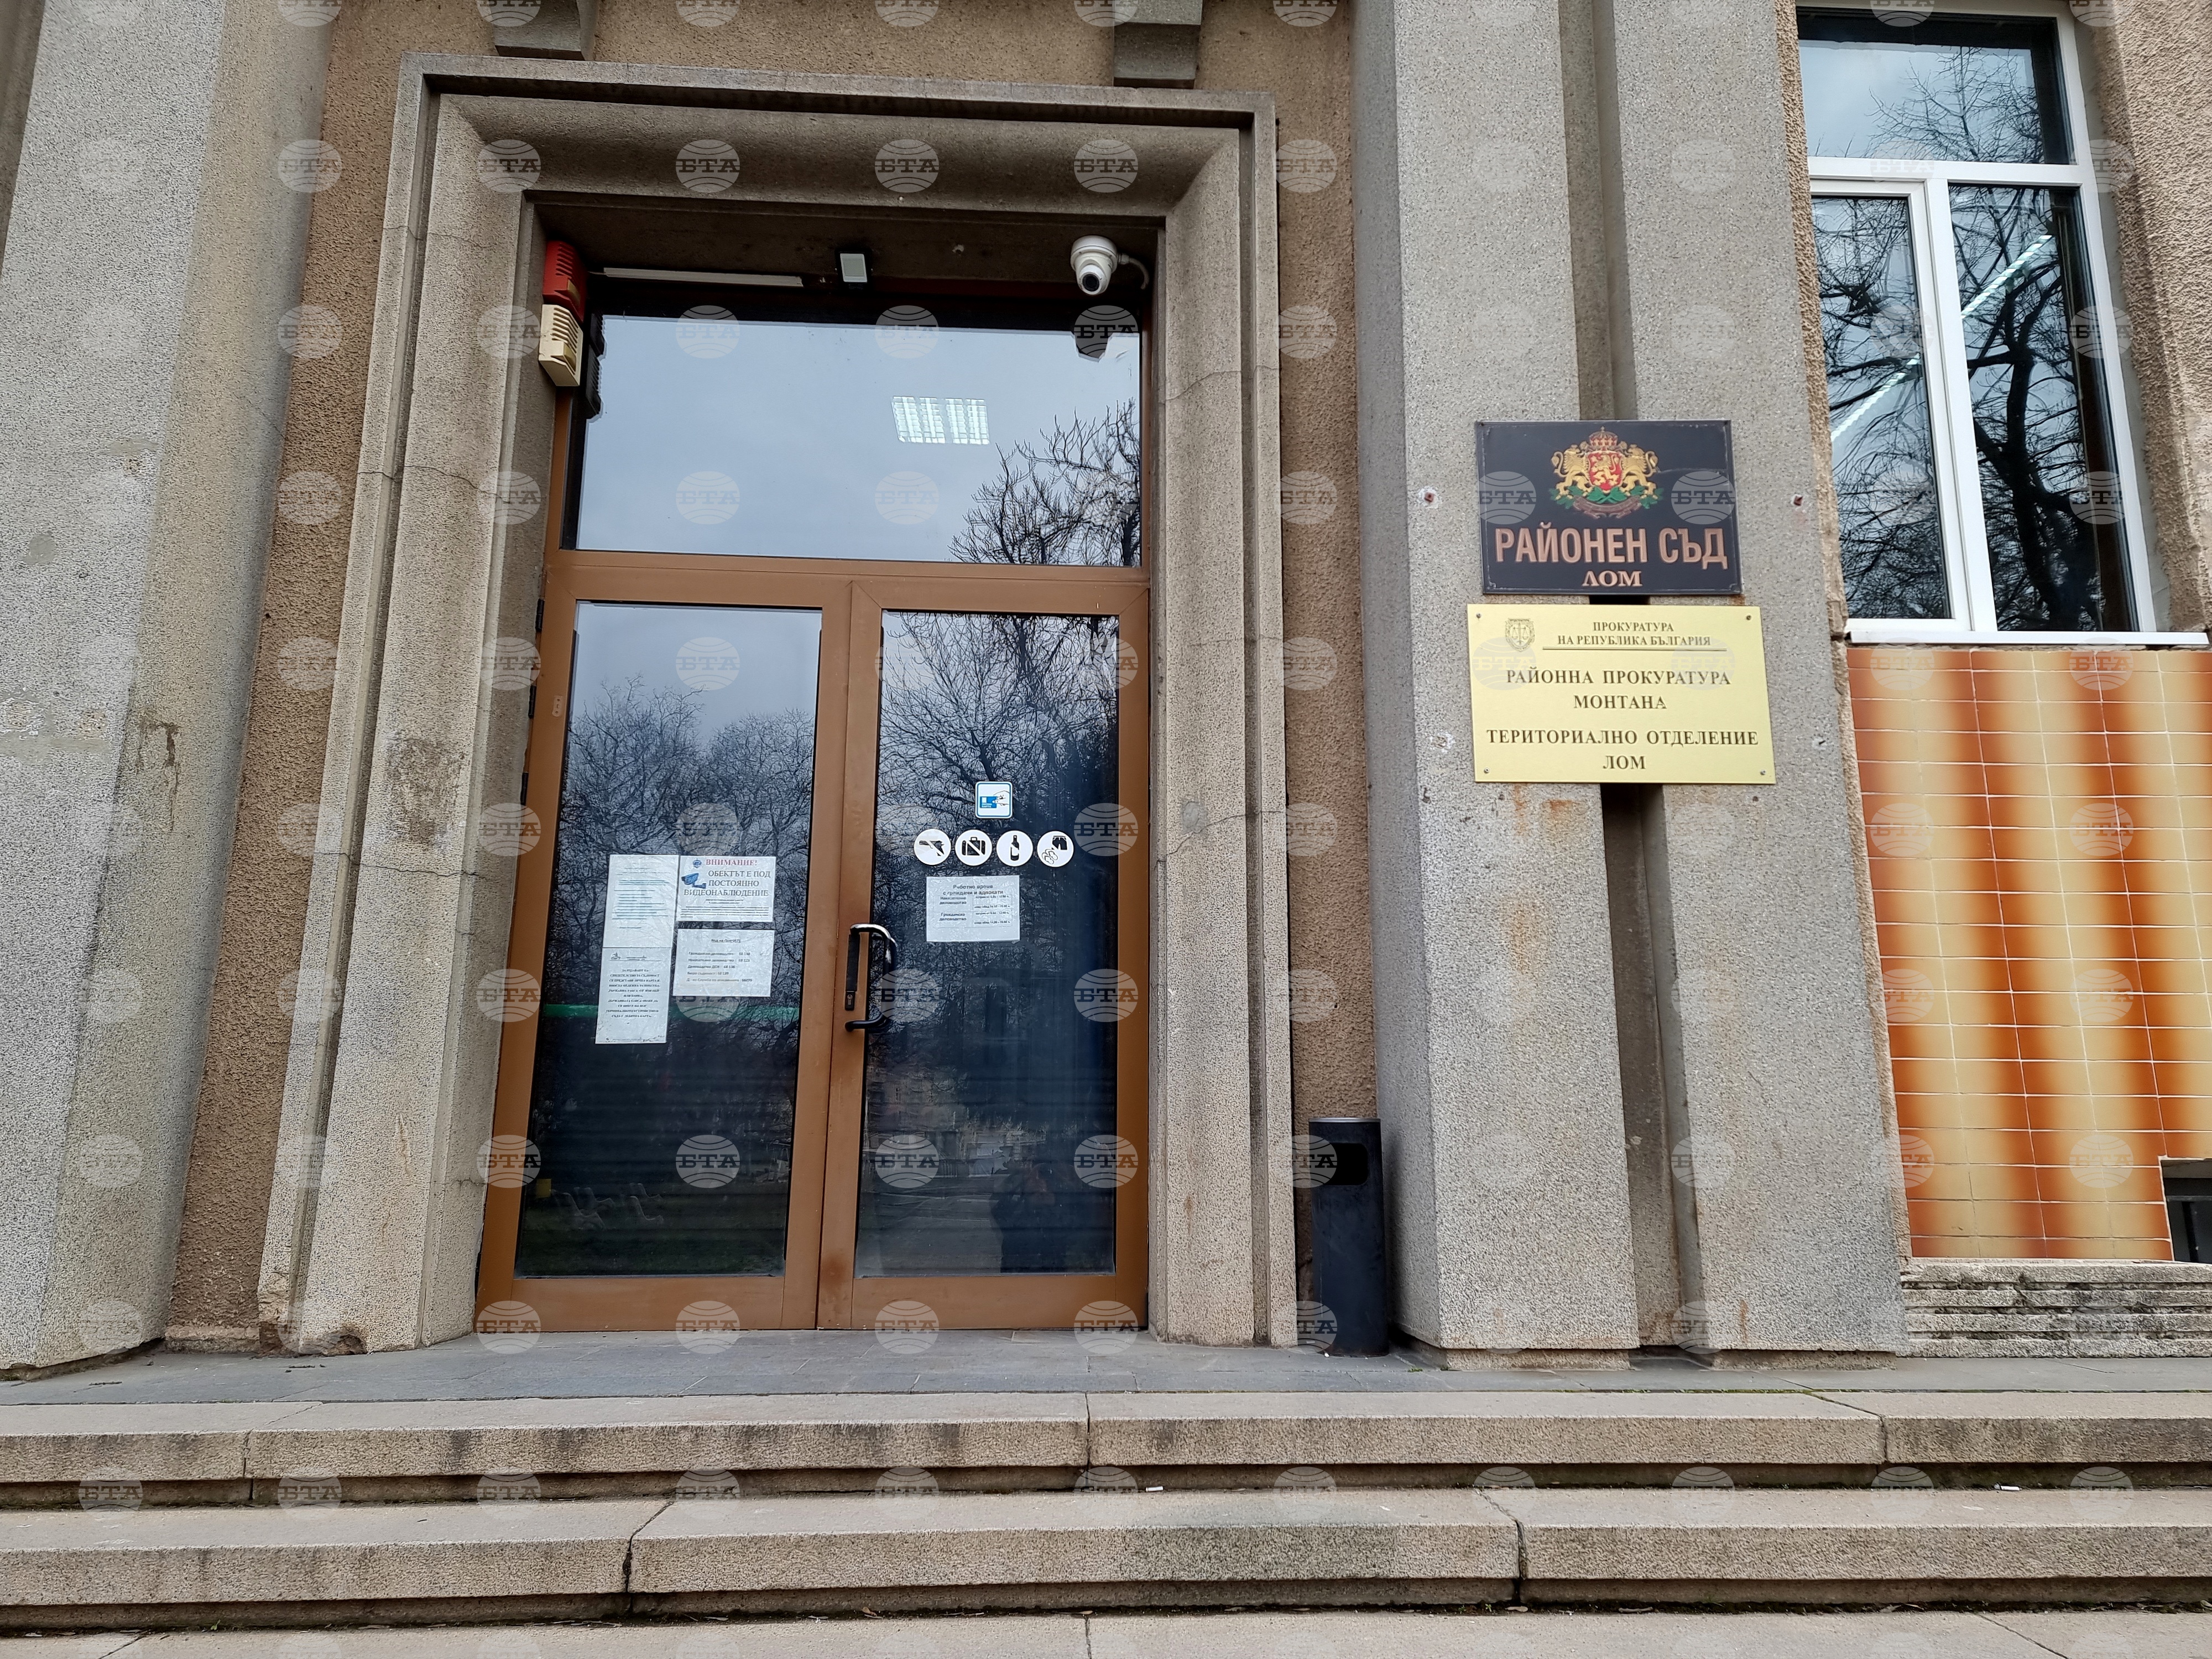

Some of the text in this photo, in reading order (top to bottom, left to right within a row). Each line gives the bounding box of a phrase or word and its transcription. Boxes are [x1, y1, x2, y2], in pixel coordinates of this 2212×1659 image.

[1495, 522, 1728, 570] РАЙОНЕН СЪД
[1582, 570, 1642, 587] ЛОМ
[1593, 621, 1674, 633] ПРОКУРАТУРА
[1557, 635, 1711, 646] НА РЕПУБЛИКА БЪЛГАРИЯ
[1507, 666, 1731, 685] РАЙОННА ПРОКУРАТУРА
[1573, 695, 1667, 709] МОНТАНА
[1486, 729, 1759, 748] ТЕРИТОРИАЛНО ОТДЕЛЕНИЕ
[1603, 755, 1646, 770] ЛОМ
